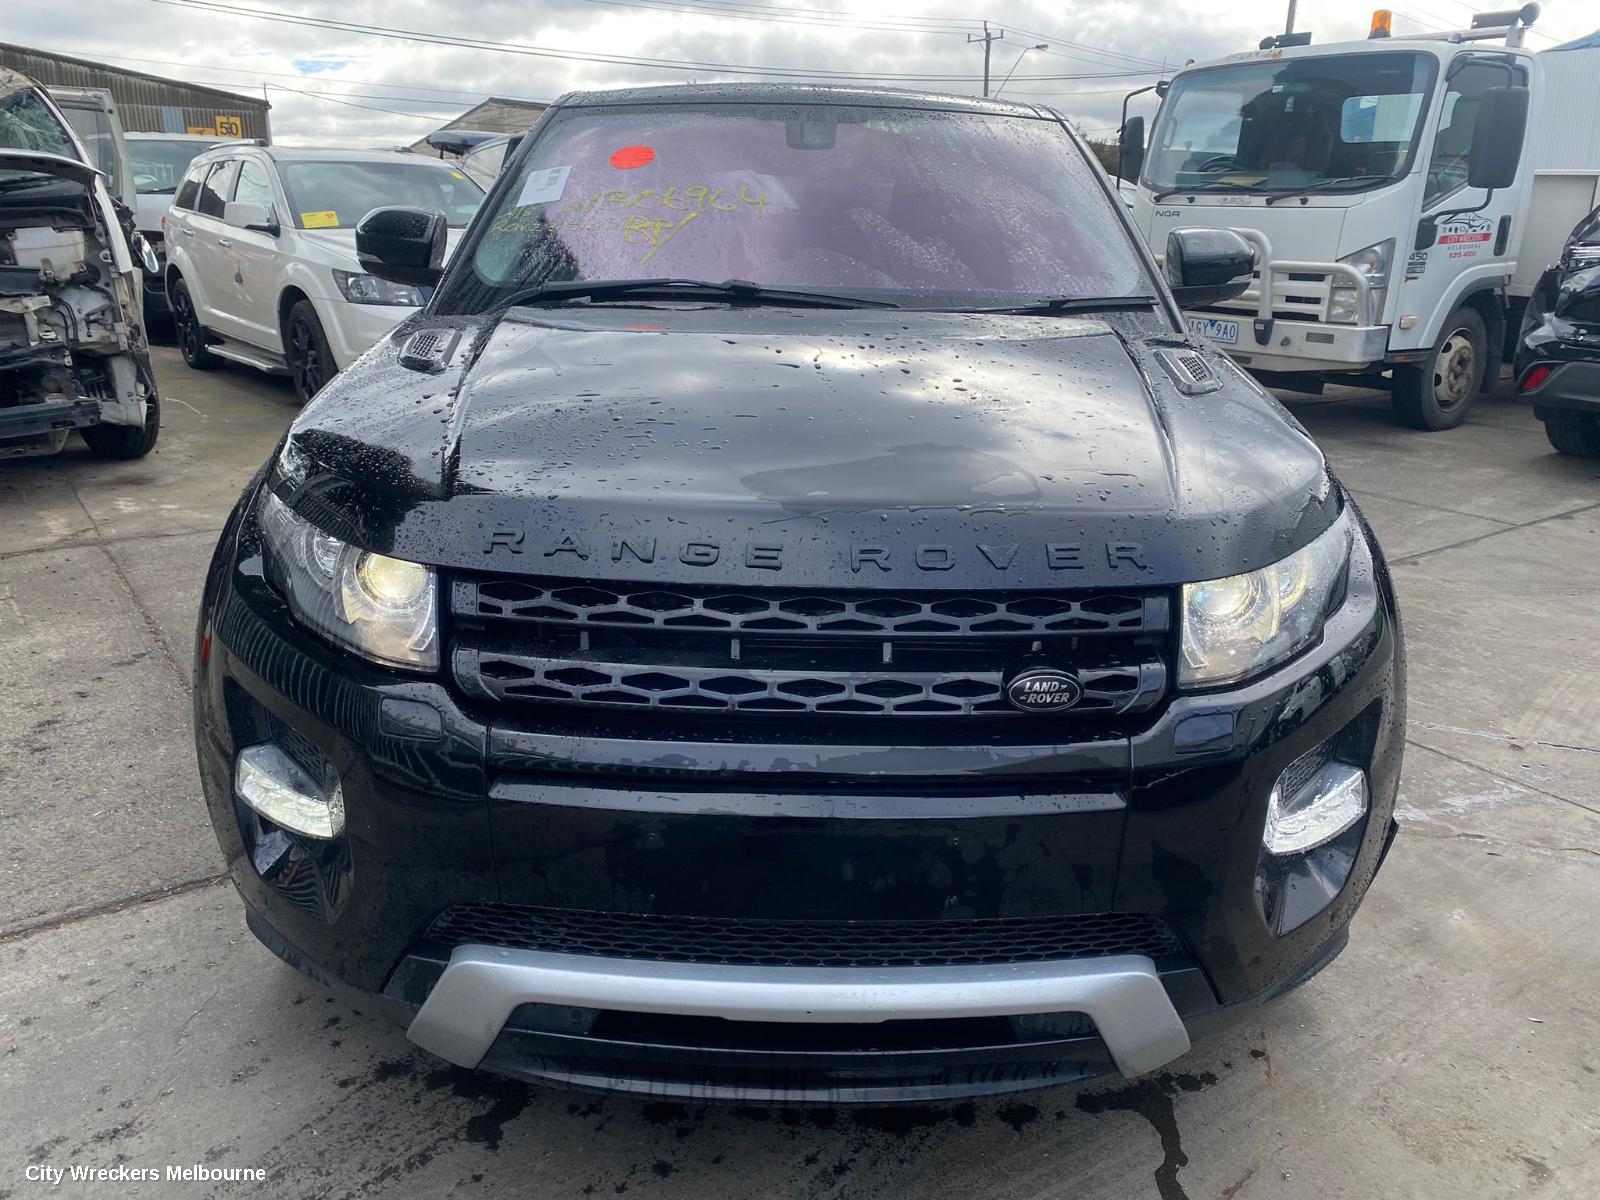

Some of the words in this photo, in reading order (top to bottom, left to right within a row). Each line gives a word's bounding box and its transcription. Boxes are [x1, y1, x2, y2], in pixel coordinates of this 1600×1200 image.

[220, 121, 239, 136] 50
[1459, 233, 1483, 242] WRECKERS
[1408, 252, 1428, 261] 450
[483, 527, 784, 572] RANGE
[850, 541, 1149, 573] ROVER
[1024, 681, 1060, 693] LAND
[1026, 692, 1070, 704] ROVER
